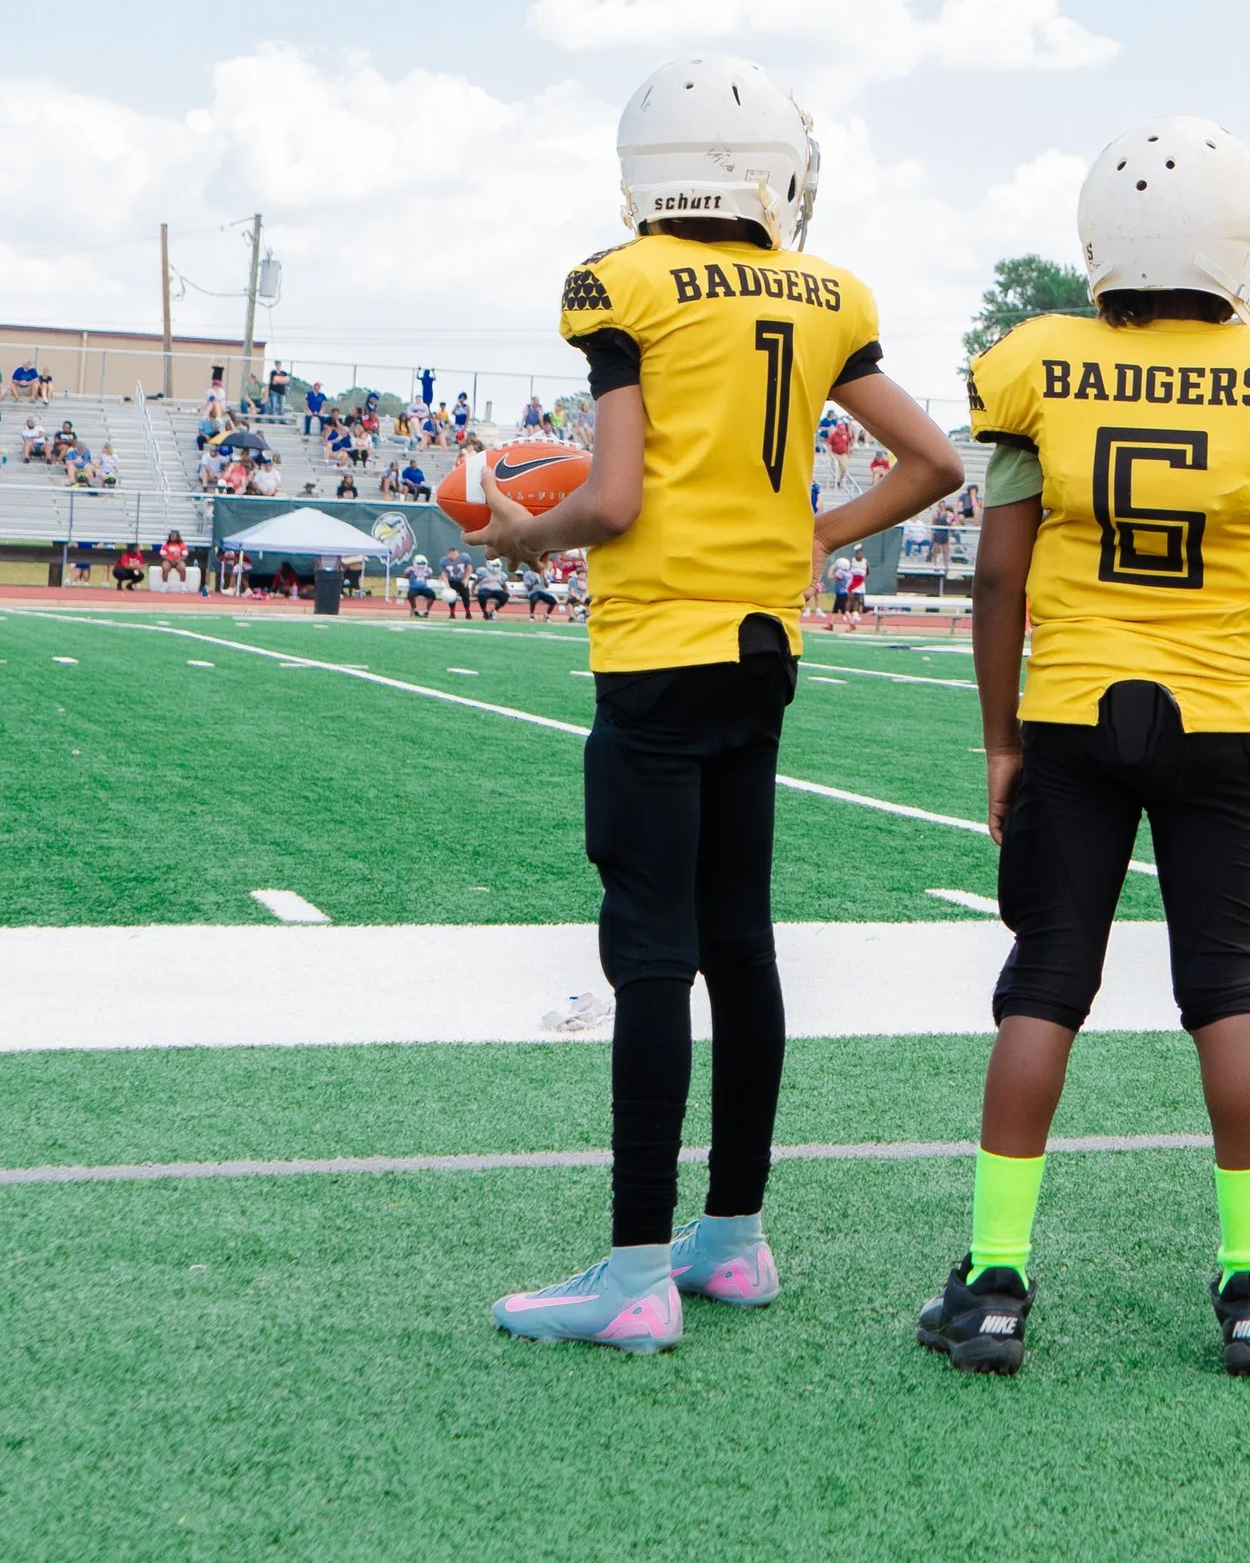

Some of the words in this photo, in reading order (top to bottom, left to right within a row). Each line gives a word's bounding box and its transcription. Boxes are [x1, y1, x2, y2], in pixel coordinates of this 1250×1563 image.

[654, 192, 723, 211] schutt
[670, 263, 841, 312] BADGERS
[755, 320, 794, 493] 1
[1092, 426, 1208, 590] 6
[979, 1314, 1018, 1335] NIKE
